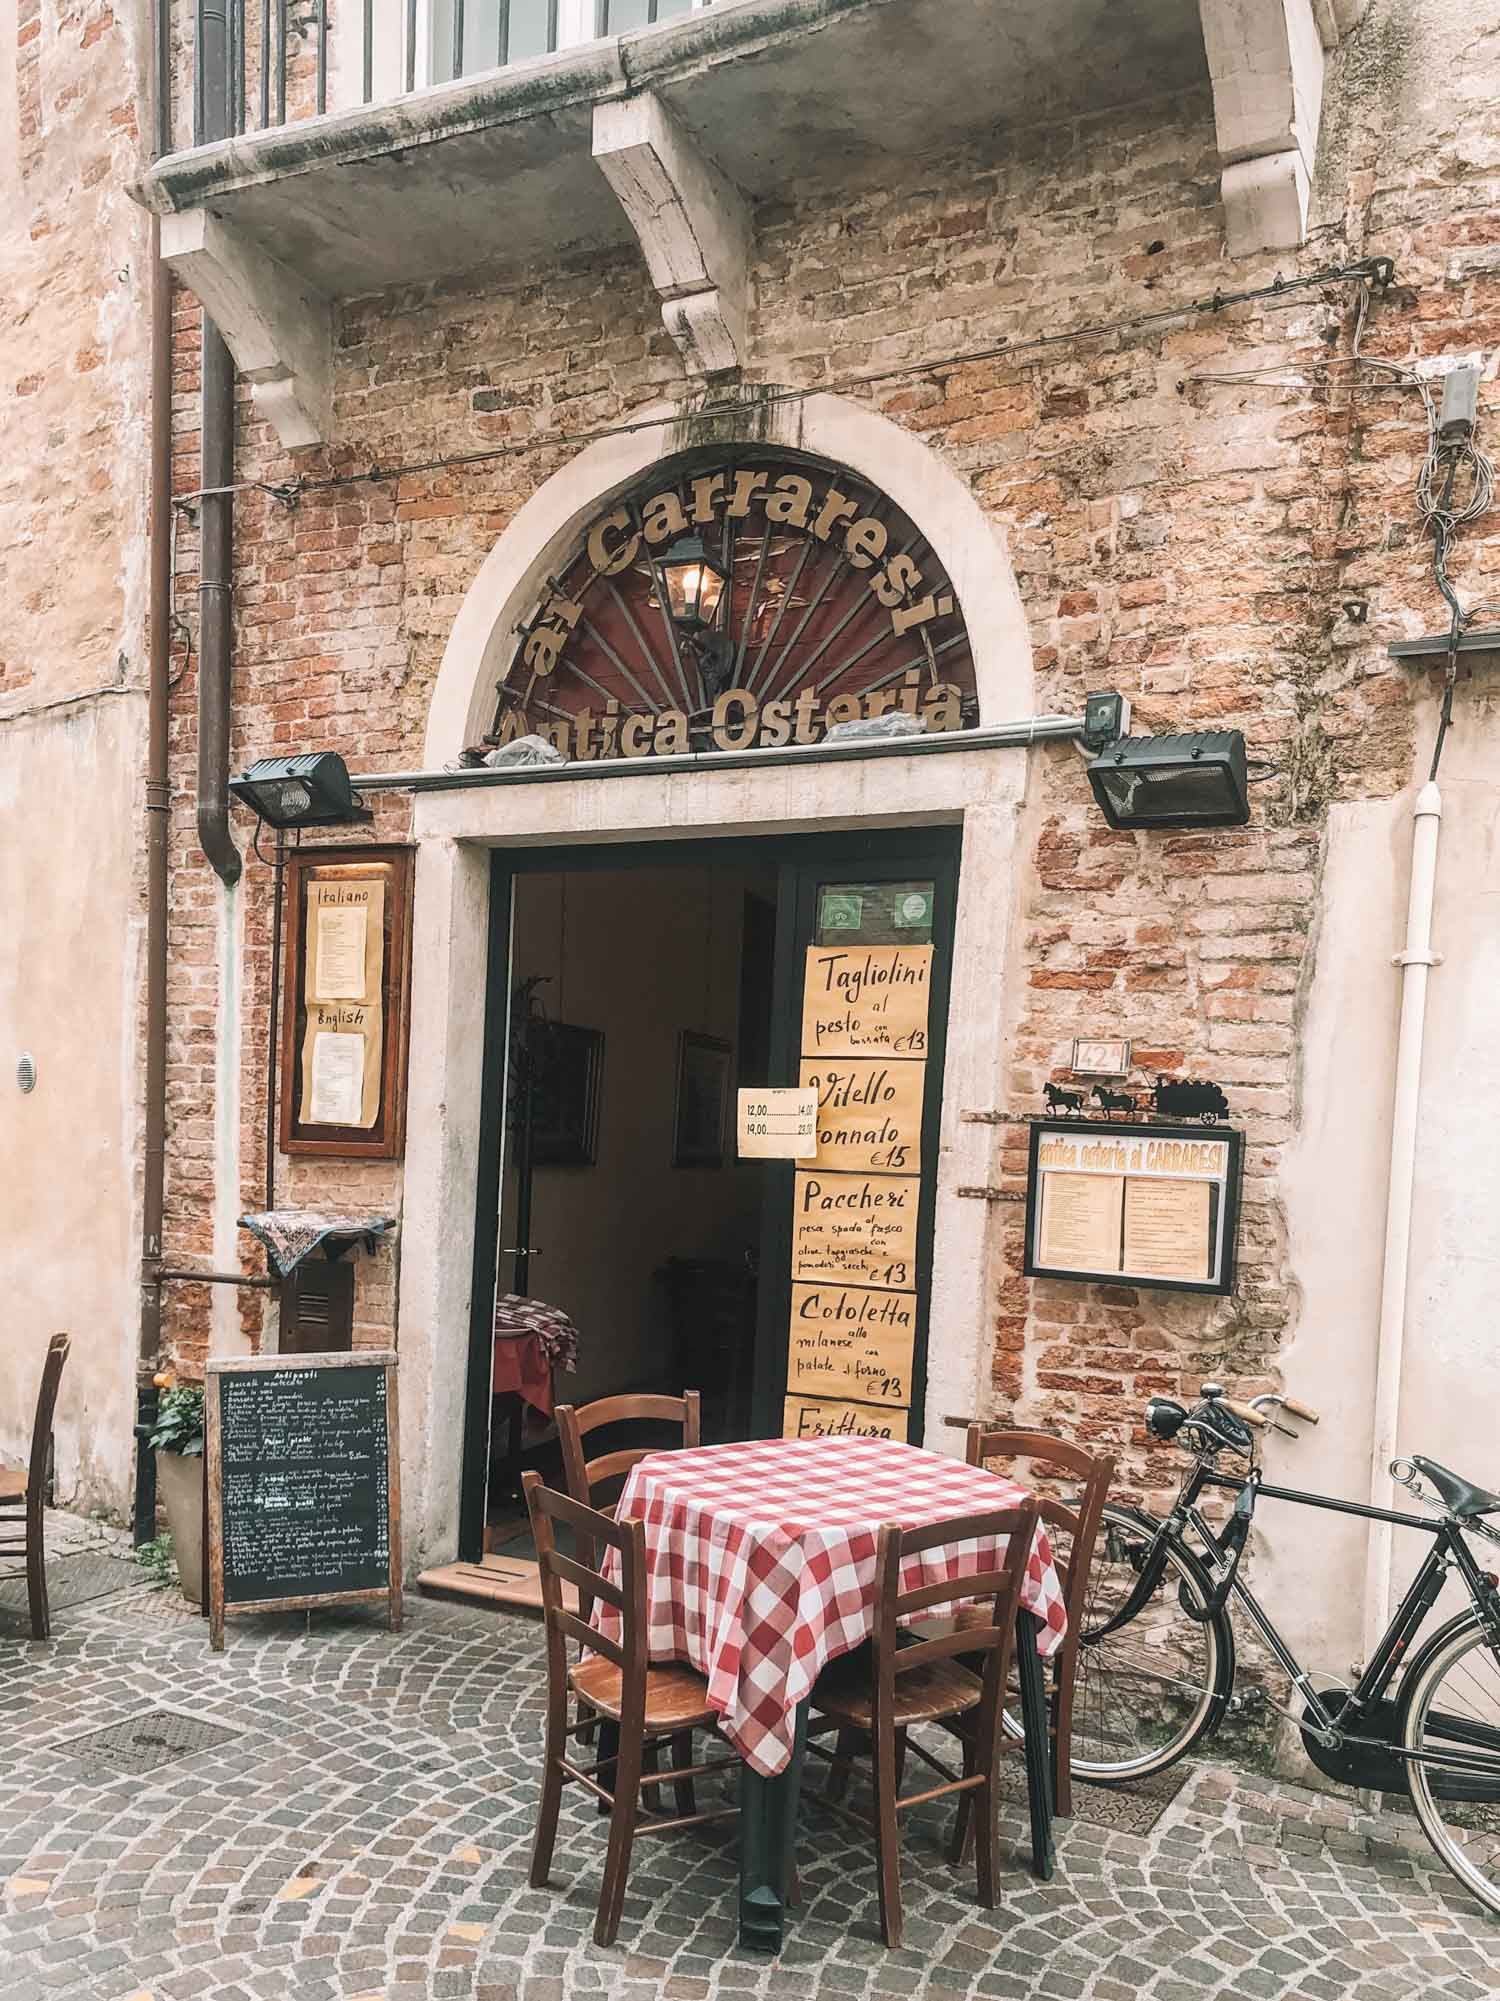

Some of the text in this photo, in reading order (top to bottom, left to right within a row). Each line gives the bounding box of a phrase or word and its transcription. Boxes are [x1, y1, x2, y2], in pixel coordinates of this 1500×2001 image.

[587, 469, 954, 638] Carraresi
[500, 669, 964, 760] Antica Osteria
[318, 887, 369, 904] Italiano
[817, 951, 927, 1003] Tagliolini
[872, 994, 889, 1013] al
[317, 1009, 365, 1032] English
[816, 1010, 861, 1046] pesto
[893, 1029, 926, 1052] €13
[809, 1070, 896, 1108] Vitello
[870, 1146, 911, 1168] €15
[1039, 1137, 1224, 1174] antica osteria ai CARRARESI
[804, 1180, 908, 1212] Paccheri
[832, 1222, 862, 1237] spada
[869, 1262, 907, 1285] €13
[800, 1292, 911, 1327] Cotoletta
[796, 1330, 853, 1349] milanese
[848, 1326, 868, 1339] alla
[797, 1357, 835, 1377] patate
[855, 1359, 888, 1380] forno
[866, 1377, 903, 1398] €13
[798, 1407, 892, 1439] Frittura
